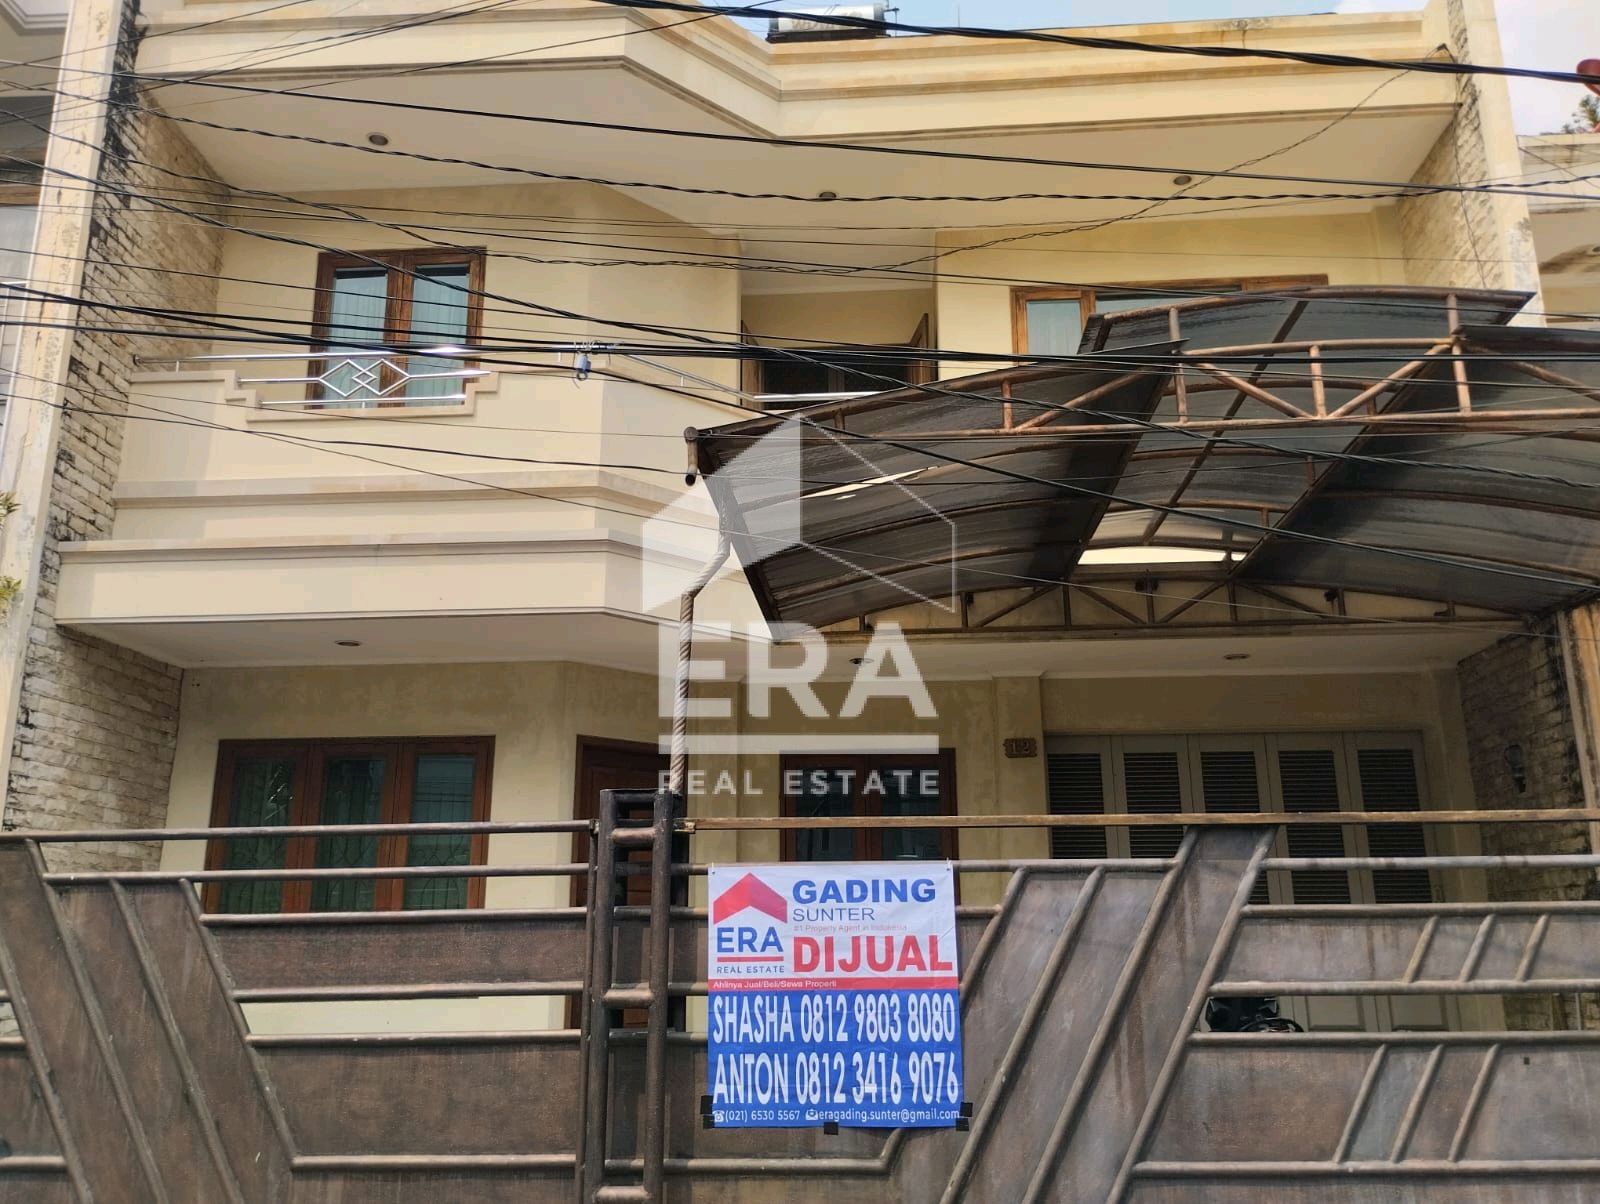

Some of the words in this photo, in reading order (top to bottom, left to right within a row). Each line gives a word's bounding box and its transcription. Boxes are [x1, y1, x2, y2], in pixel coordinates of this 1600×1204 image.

[793, 879, 936, 904] GADING
[793, 908, 875, 922] SUNTER
[839, 924, 861, 933] Agent
[717, 926, 784, 953] ERA
[793, 935, 953, 973] DIJUAL
[717, 966, 744, 974] REAL
[747, 965, 785, 974] ESTATE
[713, 981, 743, 989] Ahlinya
[805, 980, 837, 988] Properti
[713, 994, 795, 1044] SHASHA
[800, 993, 849, 1043] 0812
[854, 993, 902, 1043] 9803
[907, 993, 955, 1043] 8080
[713, 1052, 789, 1105] ANTON
[795, 1052, 846, 1105] 0812
[852, 1051, 902, 1105] 3416
[908, 1051, 958, 1105] 9076
[725, 1110, 748, 1122] (021)
[751, 1110, 774, 1120] 6530
[777, 1110, 800, 1120] 5567
[818, 1109, 960, 1122] eragading.sunter@gmail.com
